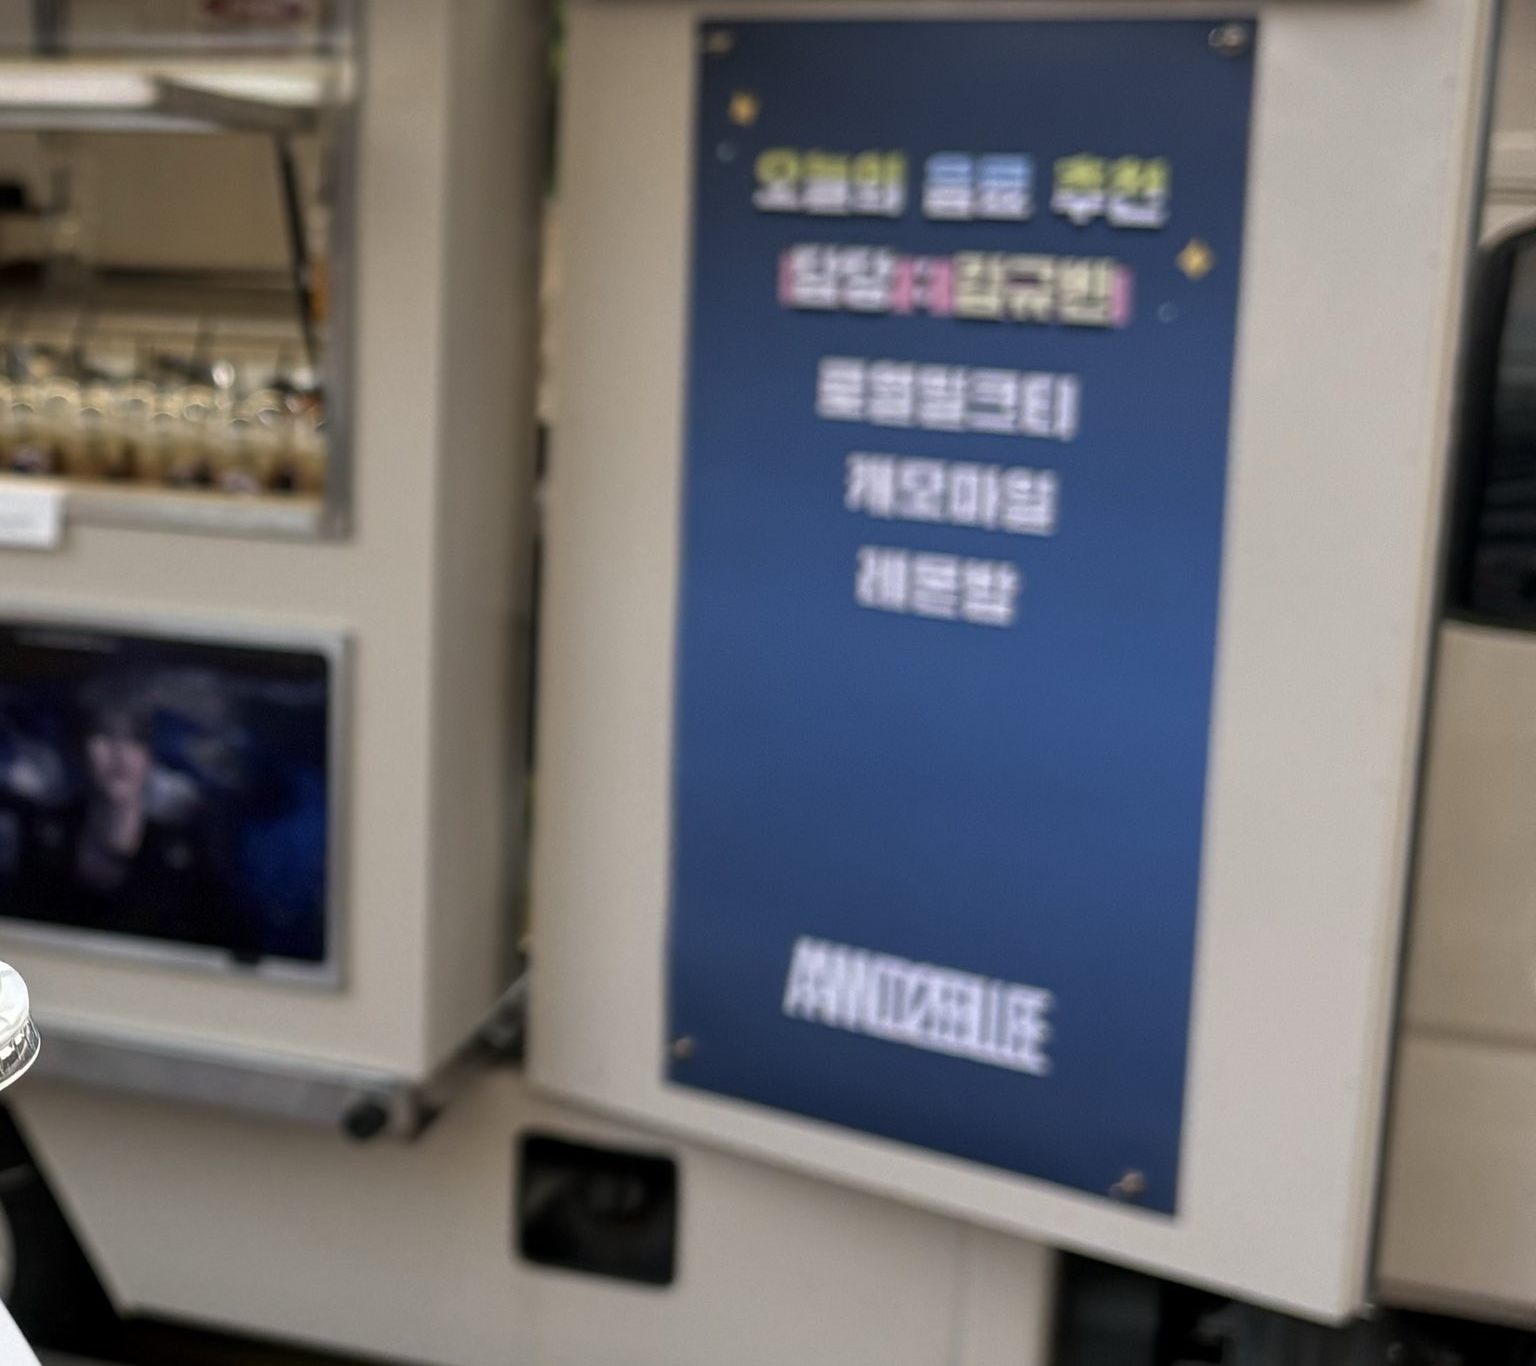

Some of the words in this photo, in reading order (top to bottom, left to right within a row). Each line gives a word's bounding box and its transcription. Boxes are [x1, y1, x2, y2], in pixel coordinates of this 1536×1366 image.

[754, 149, 908, 217] 오늘의
[1051, 154, 1170, 228] 추천
[953, 251, 1115, 327] 김규빈
[845, 451, 1059, 537] 캐모마일
